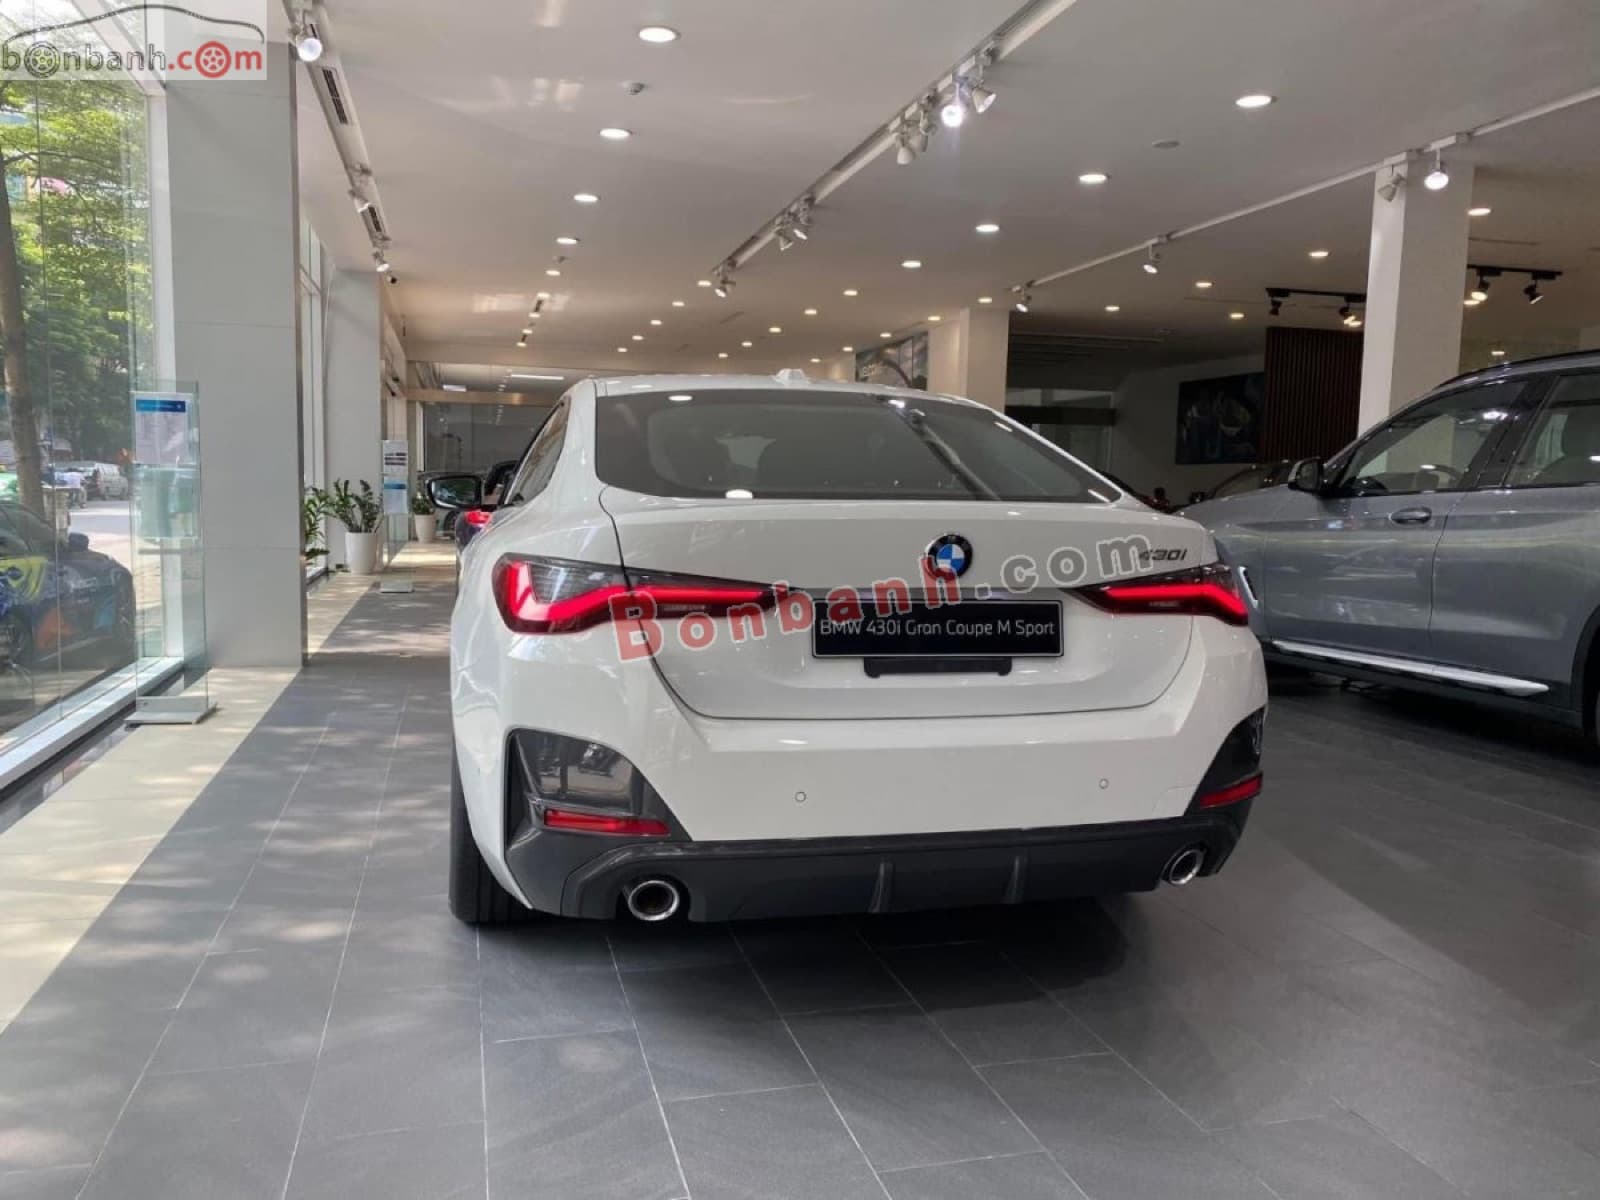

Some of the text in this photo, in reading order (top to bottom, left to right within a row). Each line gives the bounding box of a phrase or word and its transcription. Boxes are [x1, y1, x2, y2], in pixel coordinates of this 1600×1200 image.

[820, 619, 1055, 638] BMW 430i Gran Coupe M Sport
